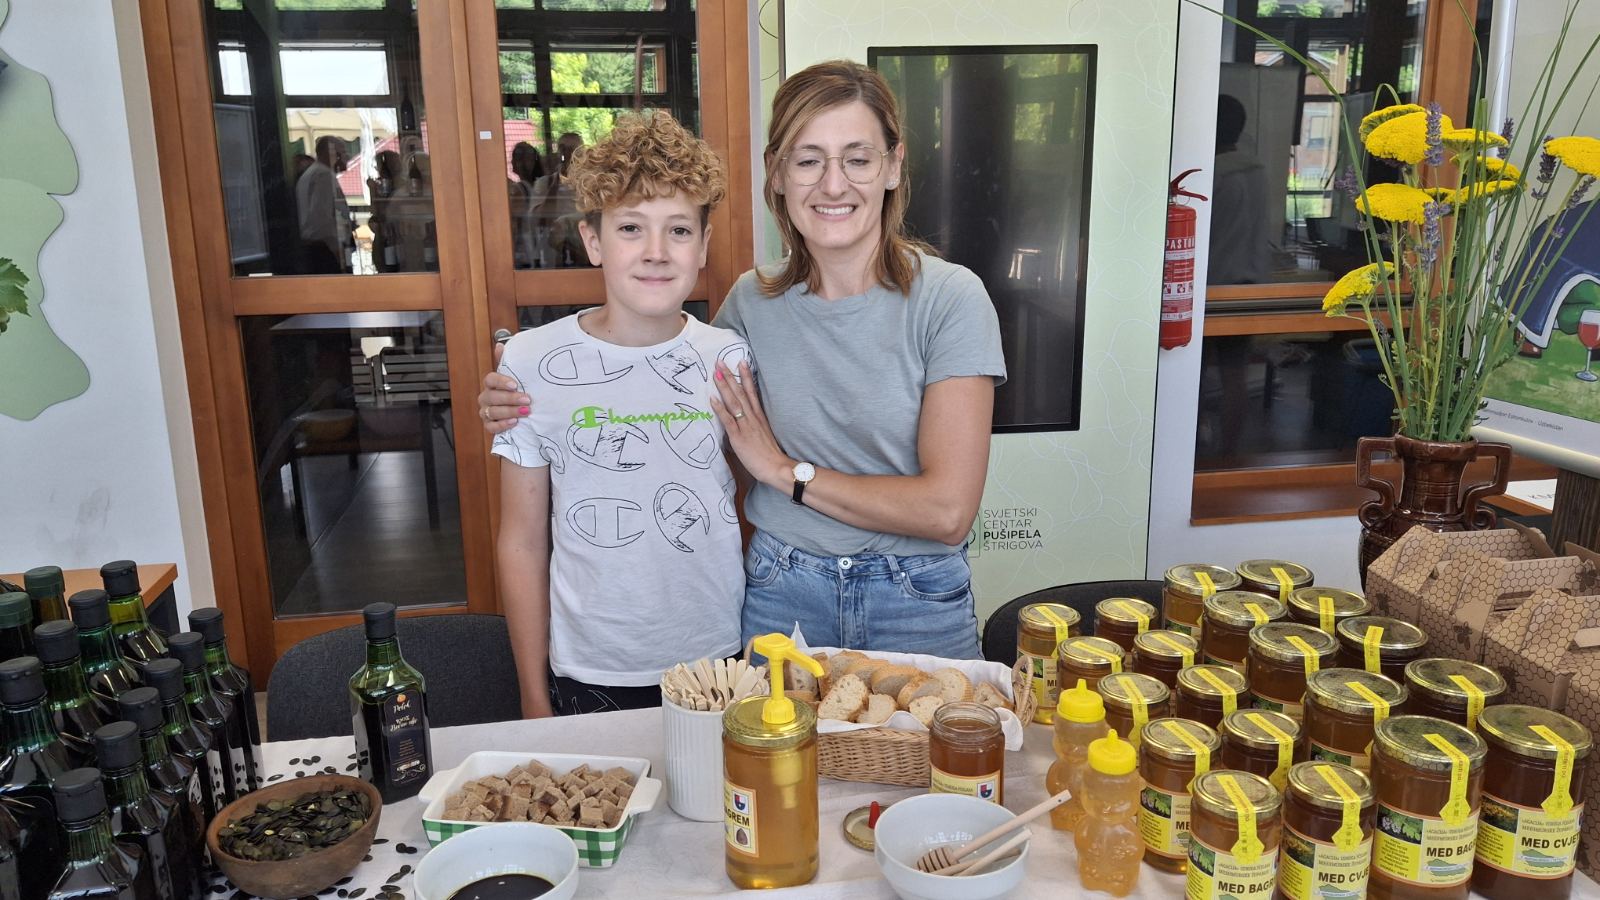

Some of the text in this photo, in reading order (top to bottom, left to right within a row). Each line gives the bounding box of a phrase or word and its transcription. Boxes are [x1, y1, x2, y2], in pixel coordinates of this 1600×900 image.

[572, 405, 714, 432] Champion
[983, 508, 1038, 519] SVJETSKI
[983, 519, 1032, 530] CENTAR
[983, 529, 1042, 540] PUŠIPELA
[983, 540, 1043, 551] ŠTRIGOVA
[1521, 836, 1550, 848] MED
[1426, 847, 1453, 857] MED
[1318, 871, 1346, 884] MED
[1218, 881, 1246, 894] MED
